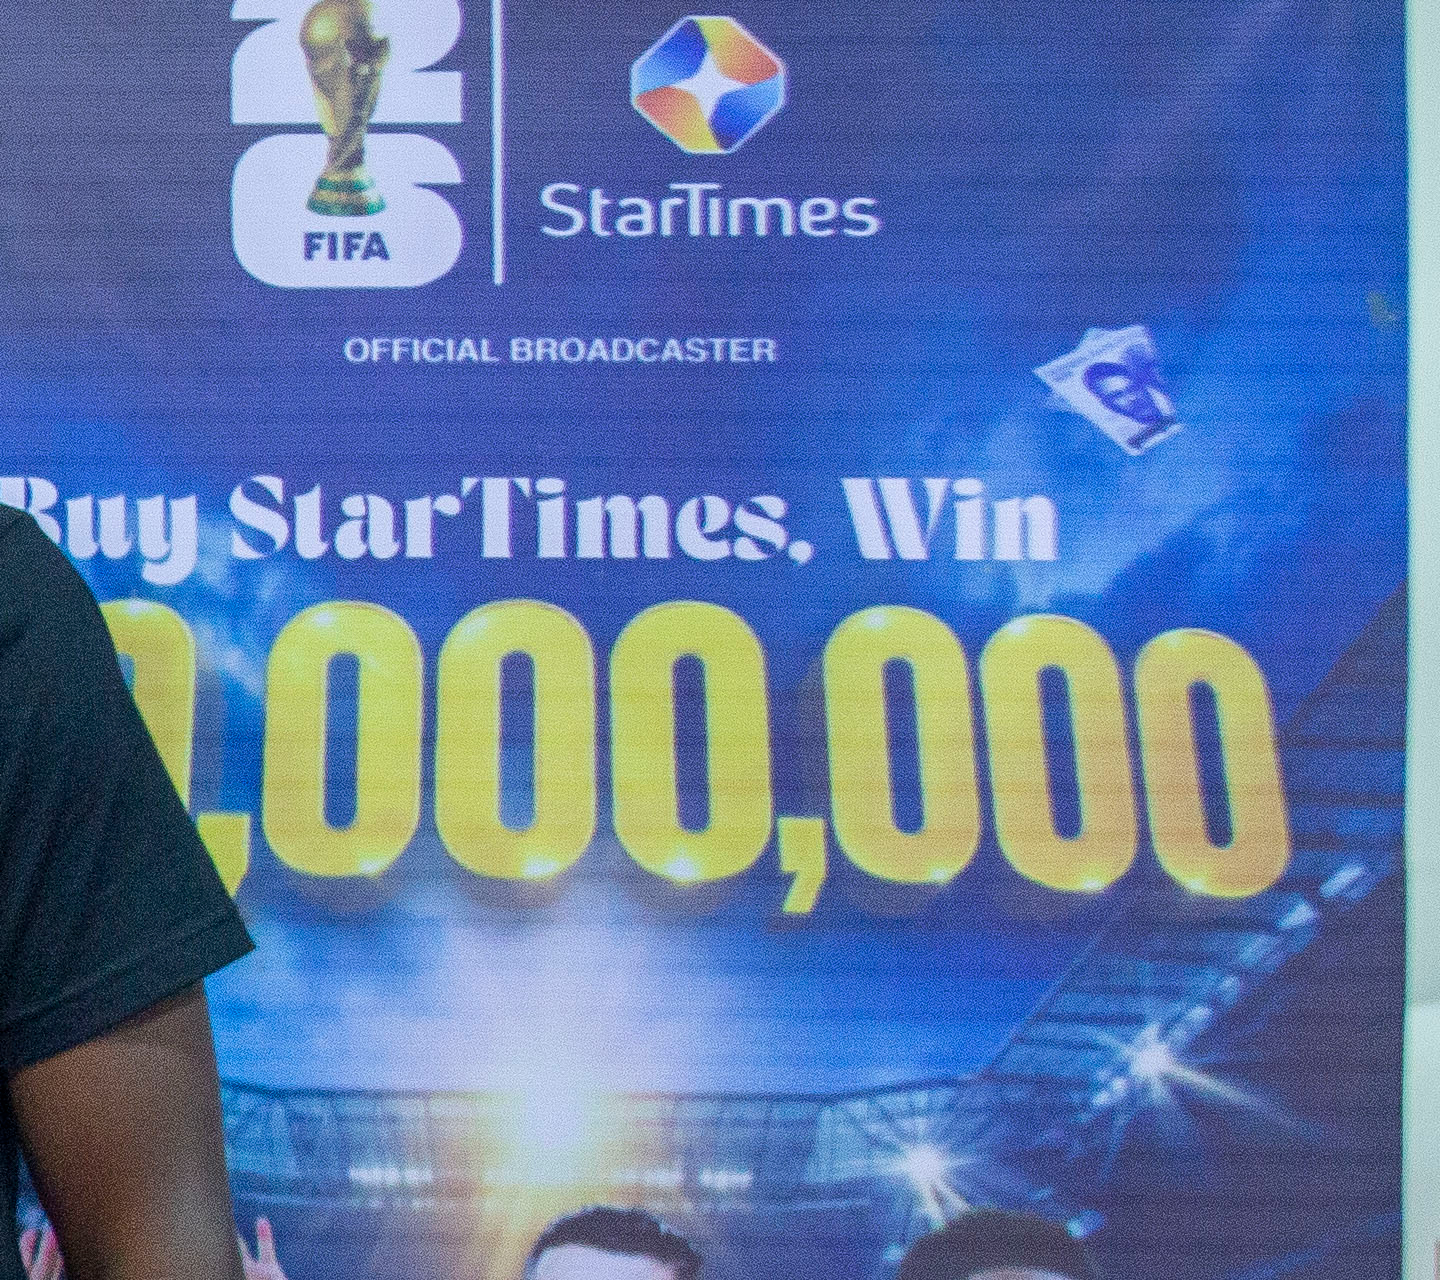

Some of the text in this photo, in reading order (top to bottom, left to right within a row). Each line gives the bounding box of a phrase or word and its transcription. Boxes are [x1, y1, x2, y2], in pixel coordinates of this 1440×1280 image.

[539, 182, 881, 237] StarTimes
[303, 230, 390, 262] FIFA
[343, 337, 777, 363] OFFICIAL BROADCASTER
[840, 476, 1058, 563] Win
